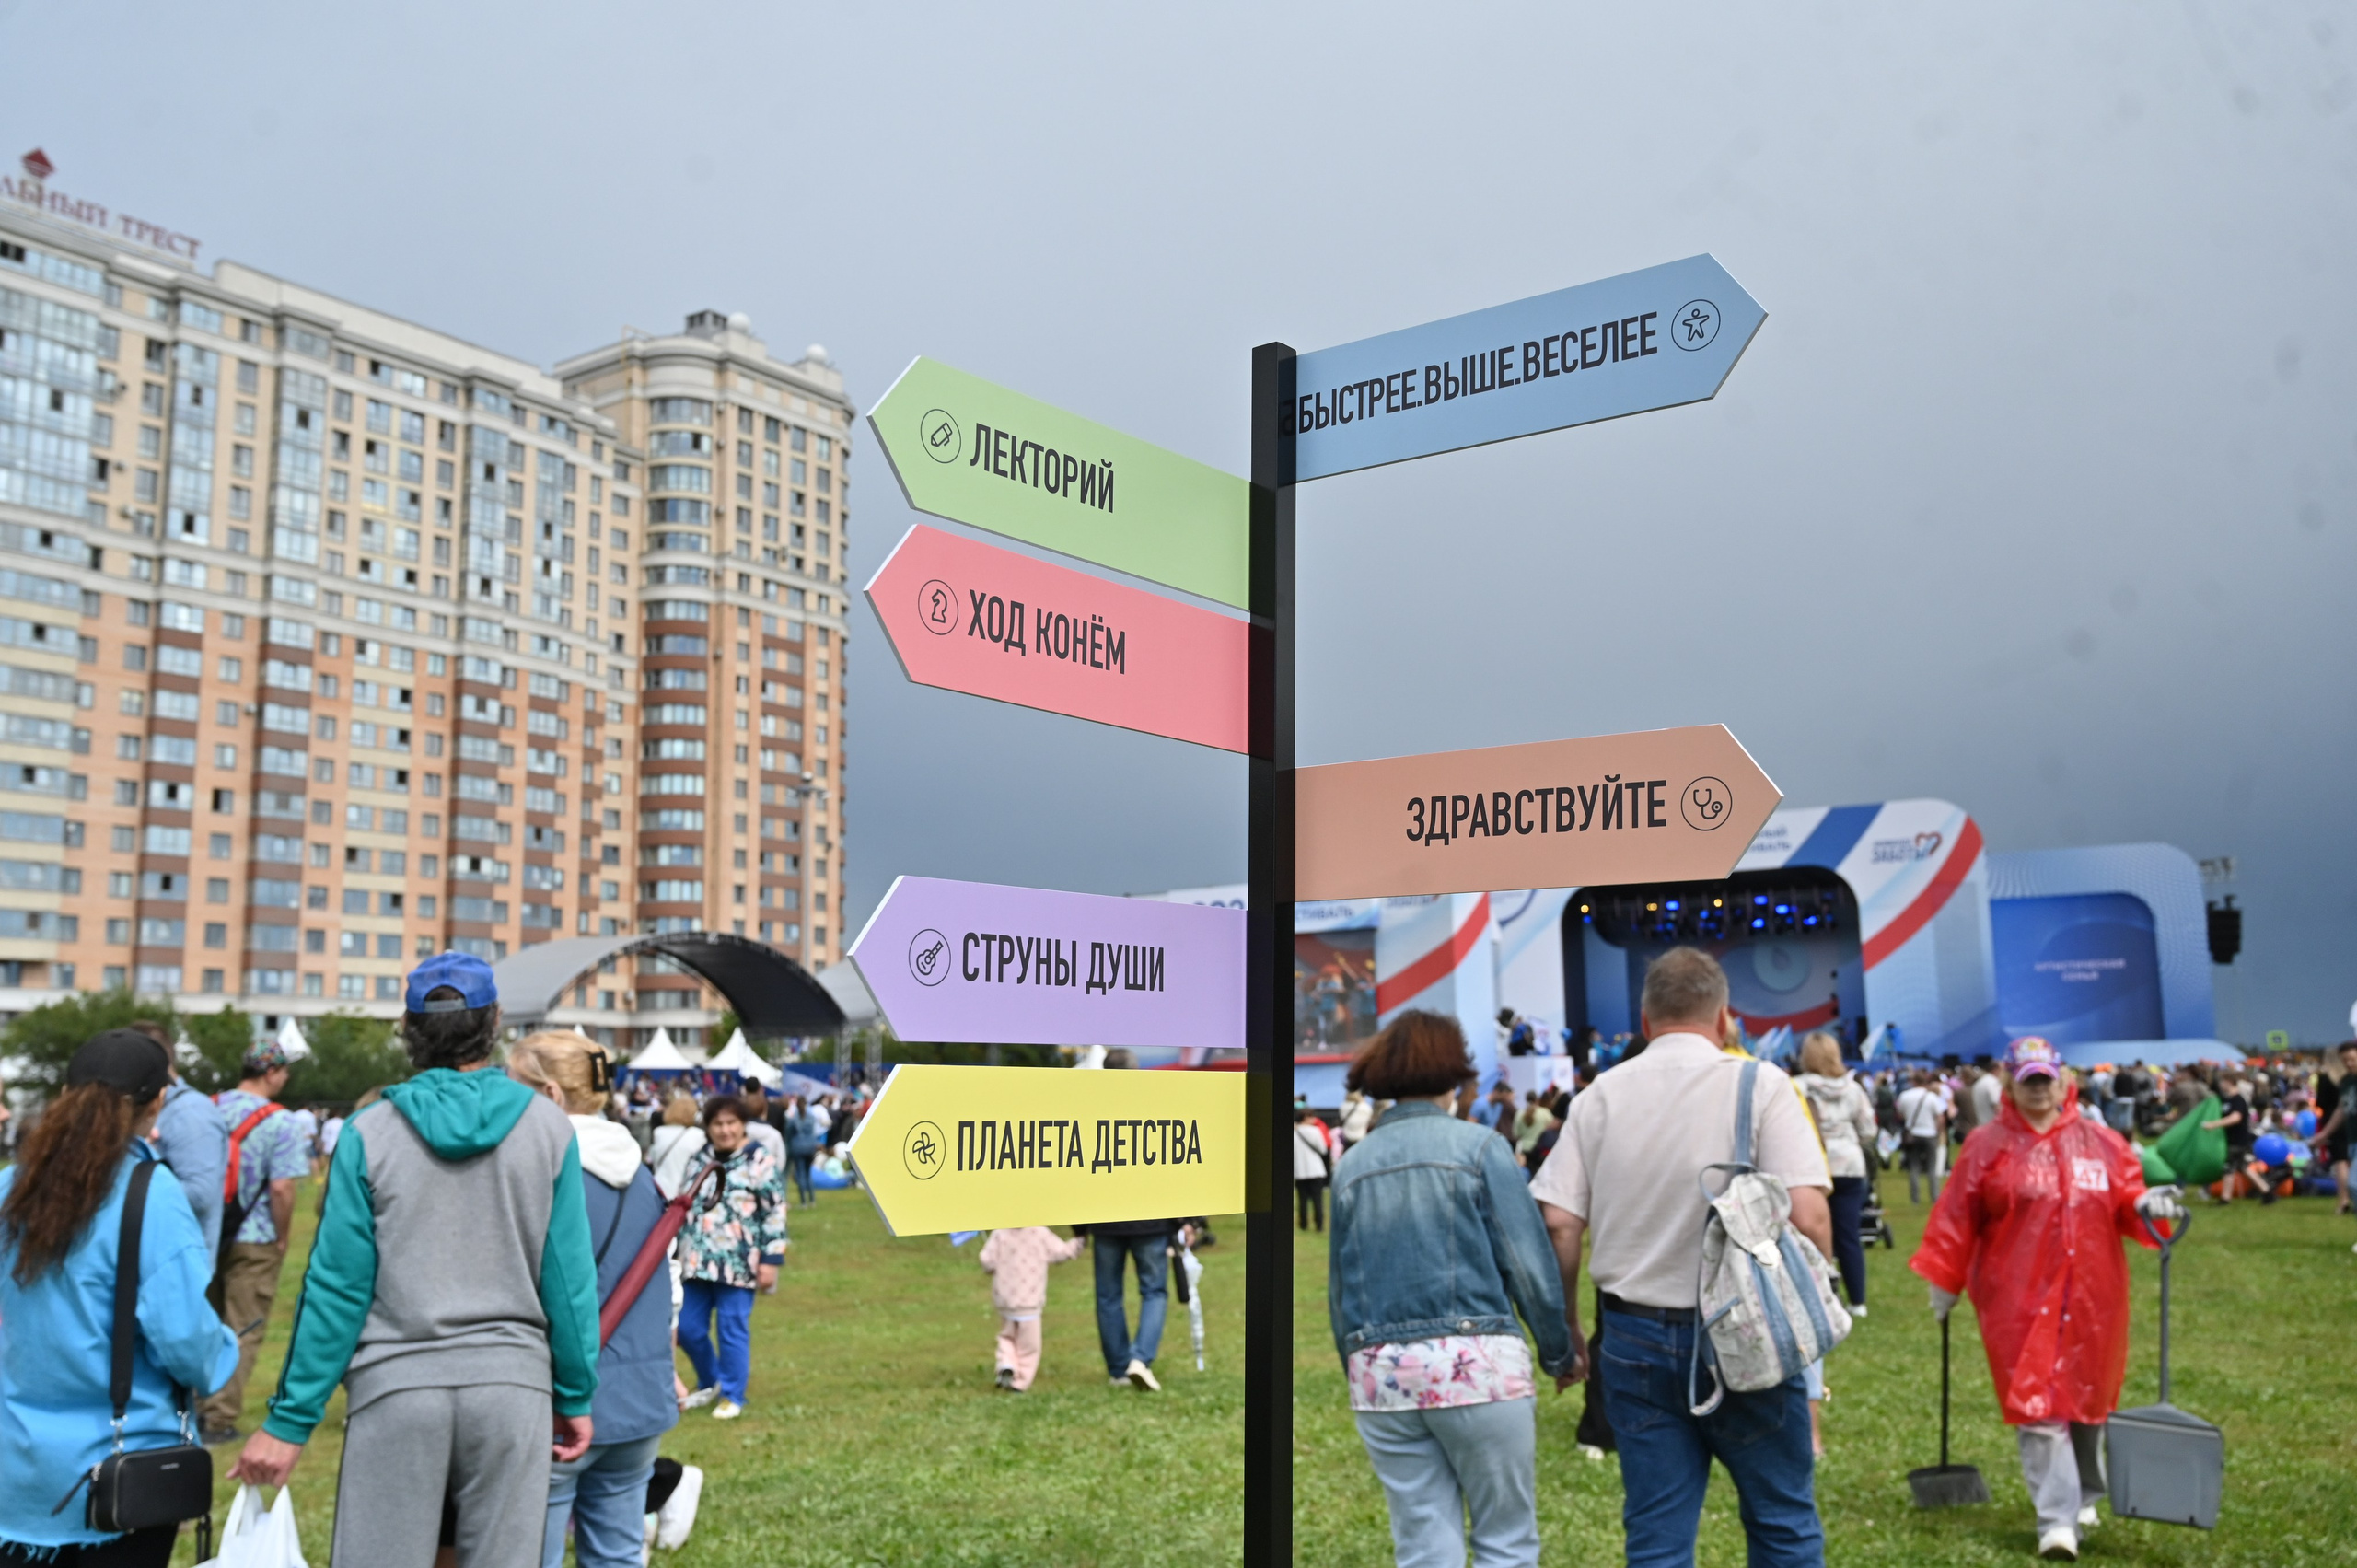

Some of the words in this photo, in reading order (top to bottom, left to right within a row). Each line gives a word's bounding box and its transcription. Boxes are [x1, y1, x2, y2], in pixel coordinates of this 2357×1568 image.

[118, 213, 202, 260] ТРЕСТ
[1298, 311, 1658, 435] БЫСТРЕЕ.ВЫШЕ.ВЕСЕЛЕЕ
[970, 423, 1115, 514] ЛЕКТОРИЙ
[968, 589, 1027, 657] ХОД
[1036, 608, 1126, 675] КОНЁМ
[1406, 773, 1667, 847] ЗДРАВСТВУЙТЕ
[962, 932, 1077, 987] СТРУНЫ
[1086, 941, 1165, 996] ДУШИ
[957, 1120, 1085, 1171] ПЛАНЕТА
[1091, 1119, 1202, 1174] ДЕТСТВА
